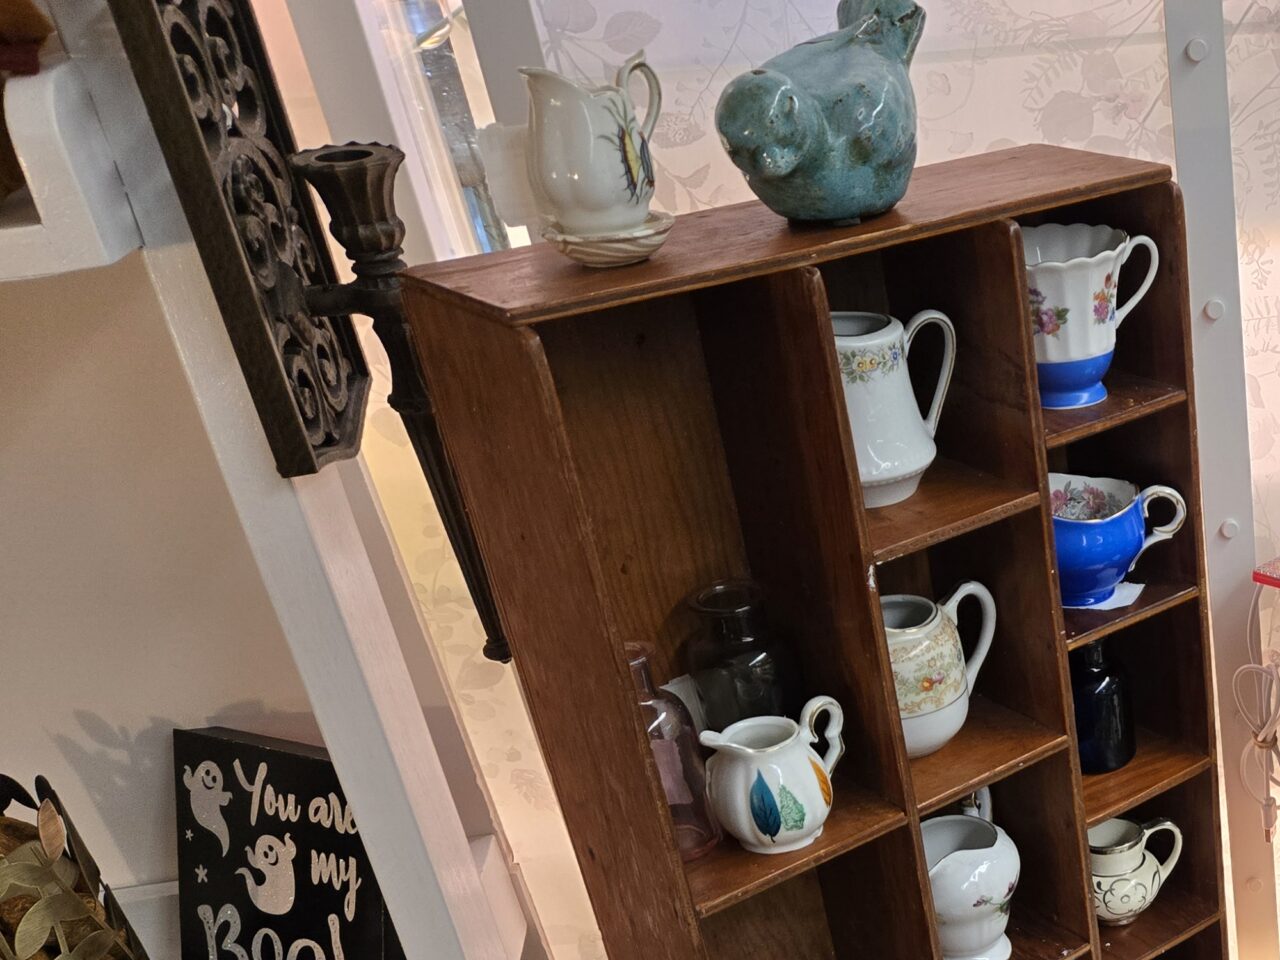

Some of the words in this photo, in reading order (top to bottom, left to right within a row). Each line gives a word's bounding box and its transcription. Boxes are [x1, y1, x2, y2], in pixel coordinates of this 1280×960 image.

[232, 758, 301, 826] You
[308, 791, 360, 835] are
[310, 848, 362, 922] my
